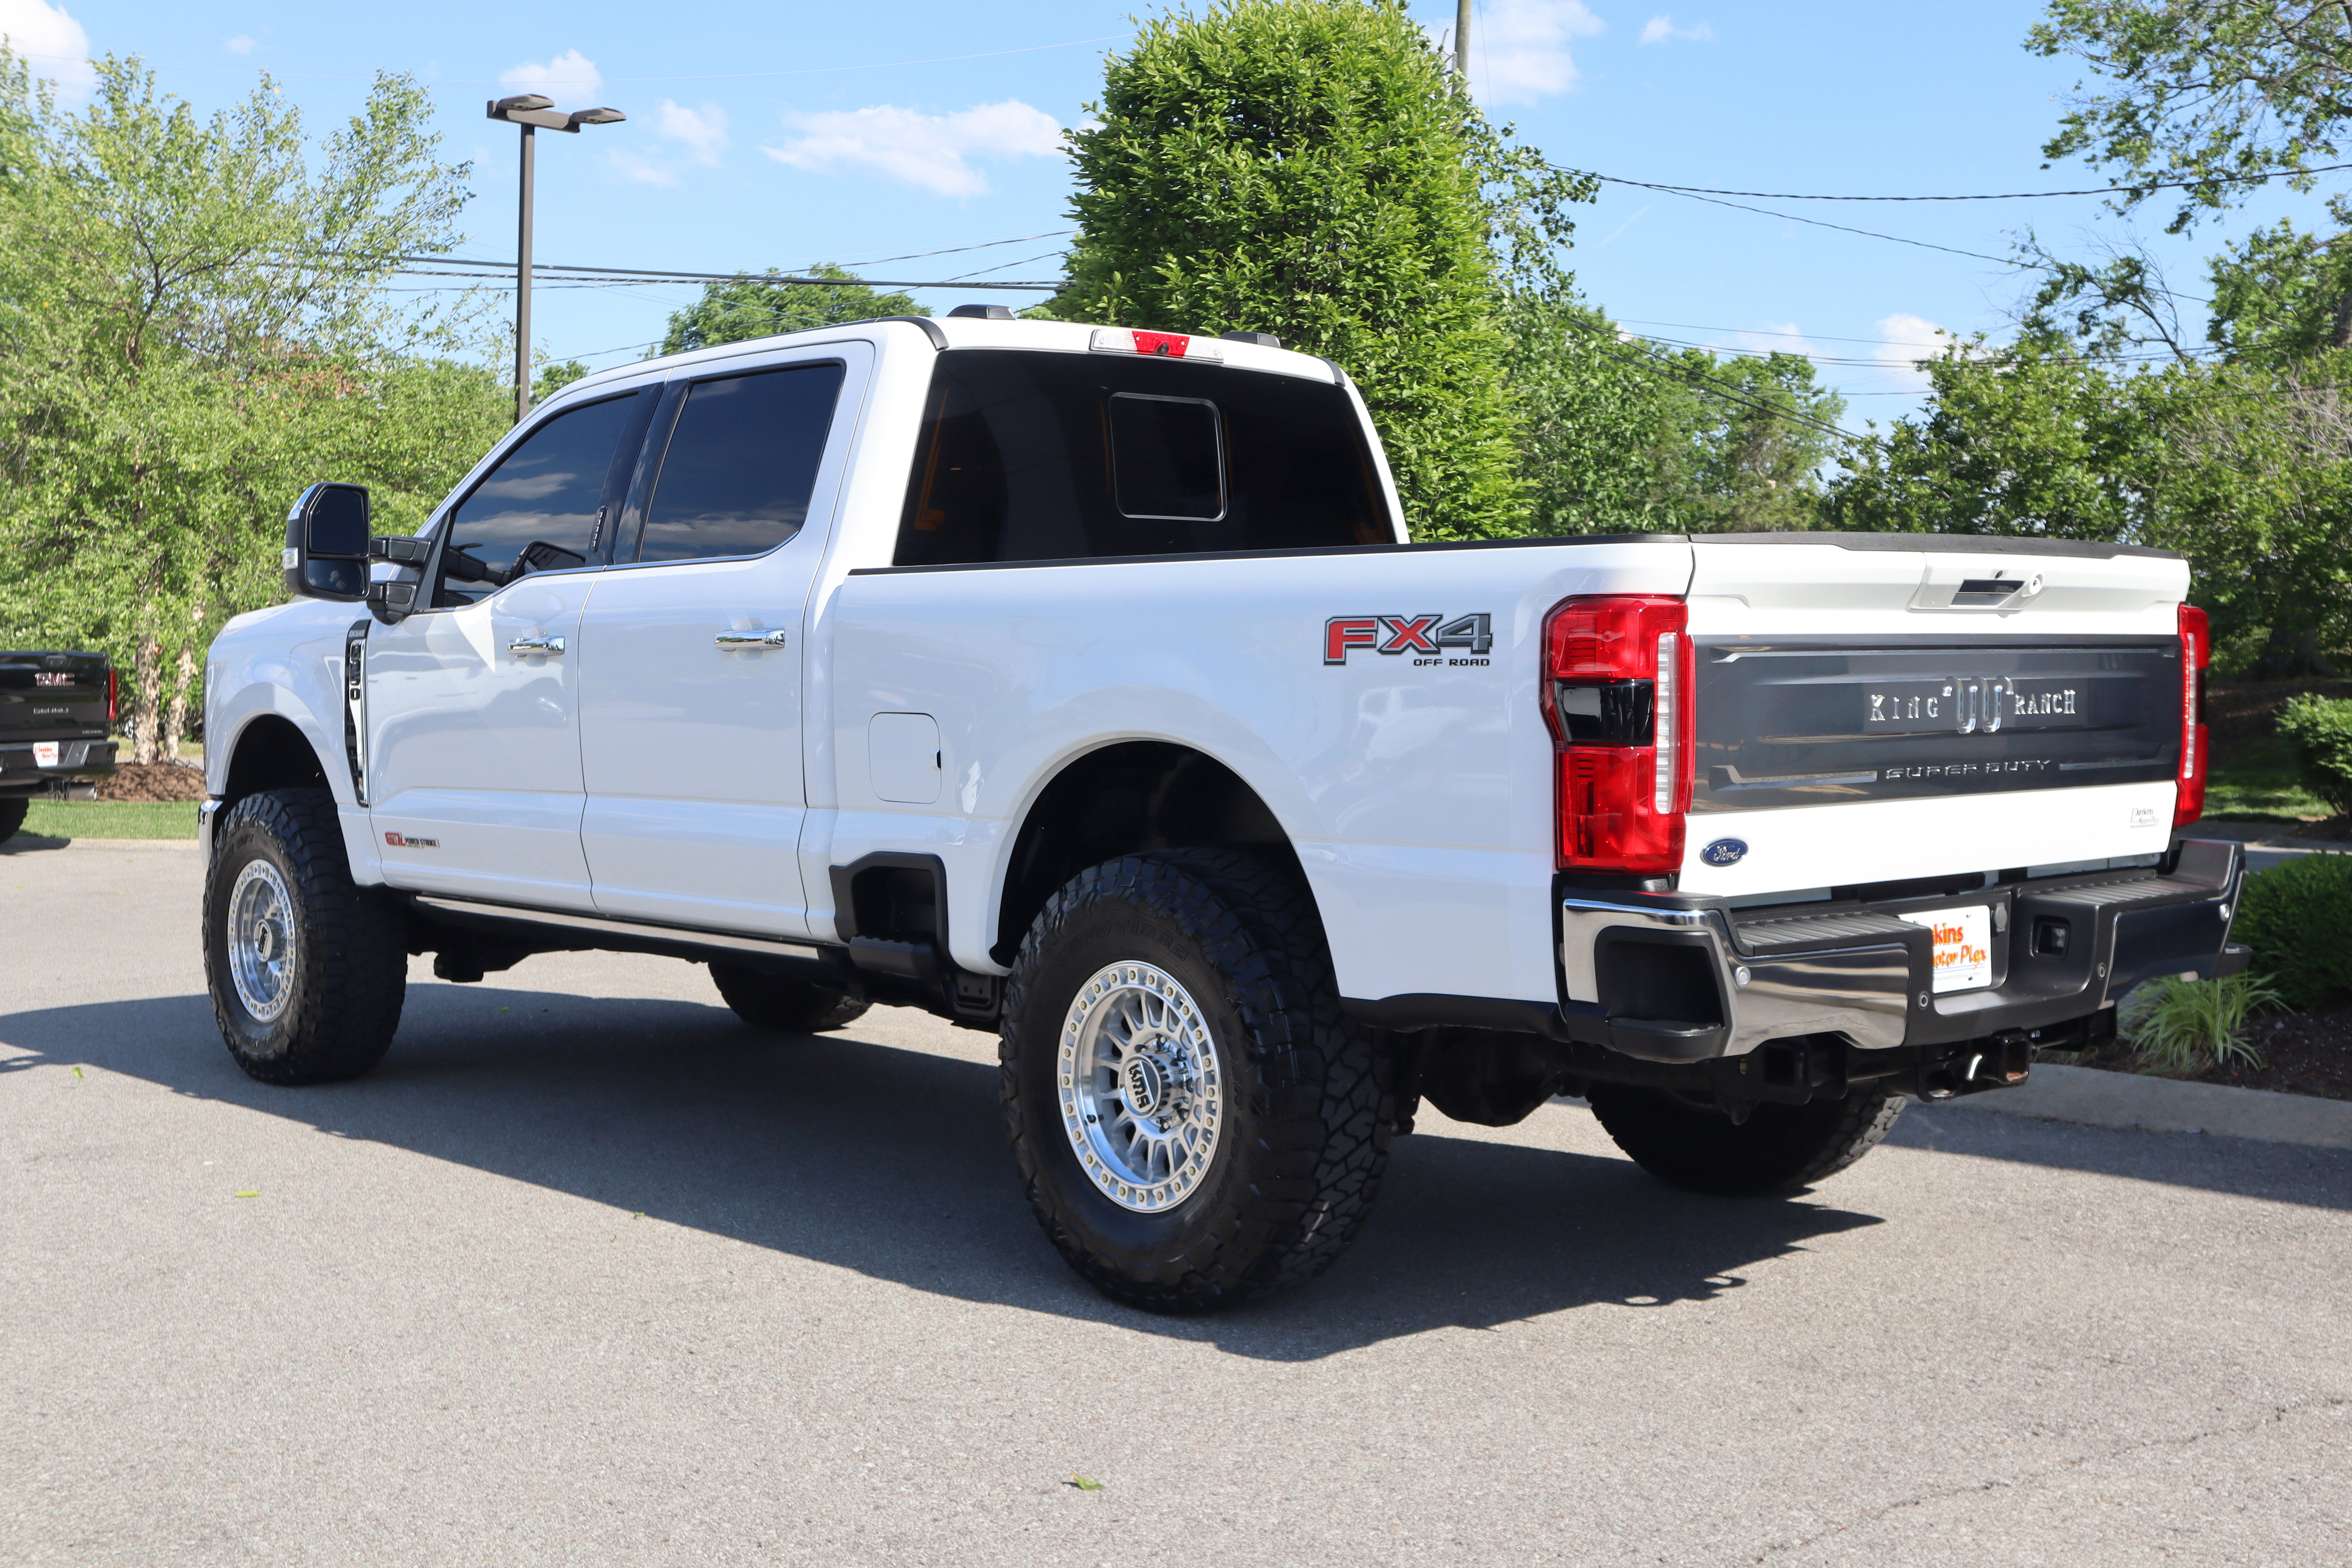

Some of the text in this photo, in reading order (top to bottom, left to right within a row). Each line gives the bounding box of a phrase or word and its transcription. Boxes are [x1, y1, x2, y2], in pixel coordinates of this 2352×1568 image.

[1323, 612, 1493, 666] FX4
[1870, 694, 1939, 721] KING
[2015, 689, 2076, 715] RANCH
[1886, 760, 2051, 779] SUPER DUTY
[2130, 807, 2154, 822] Perkins
[1961, 944, 1987, 968] Plex
